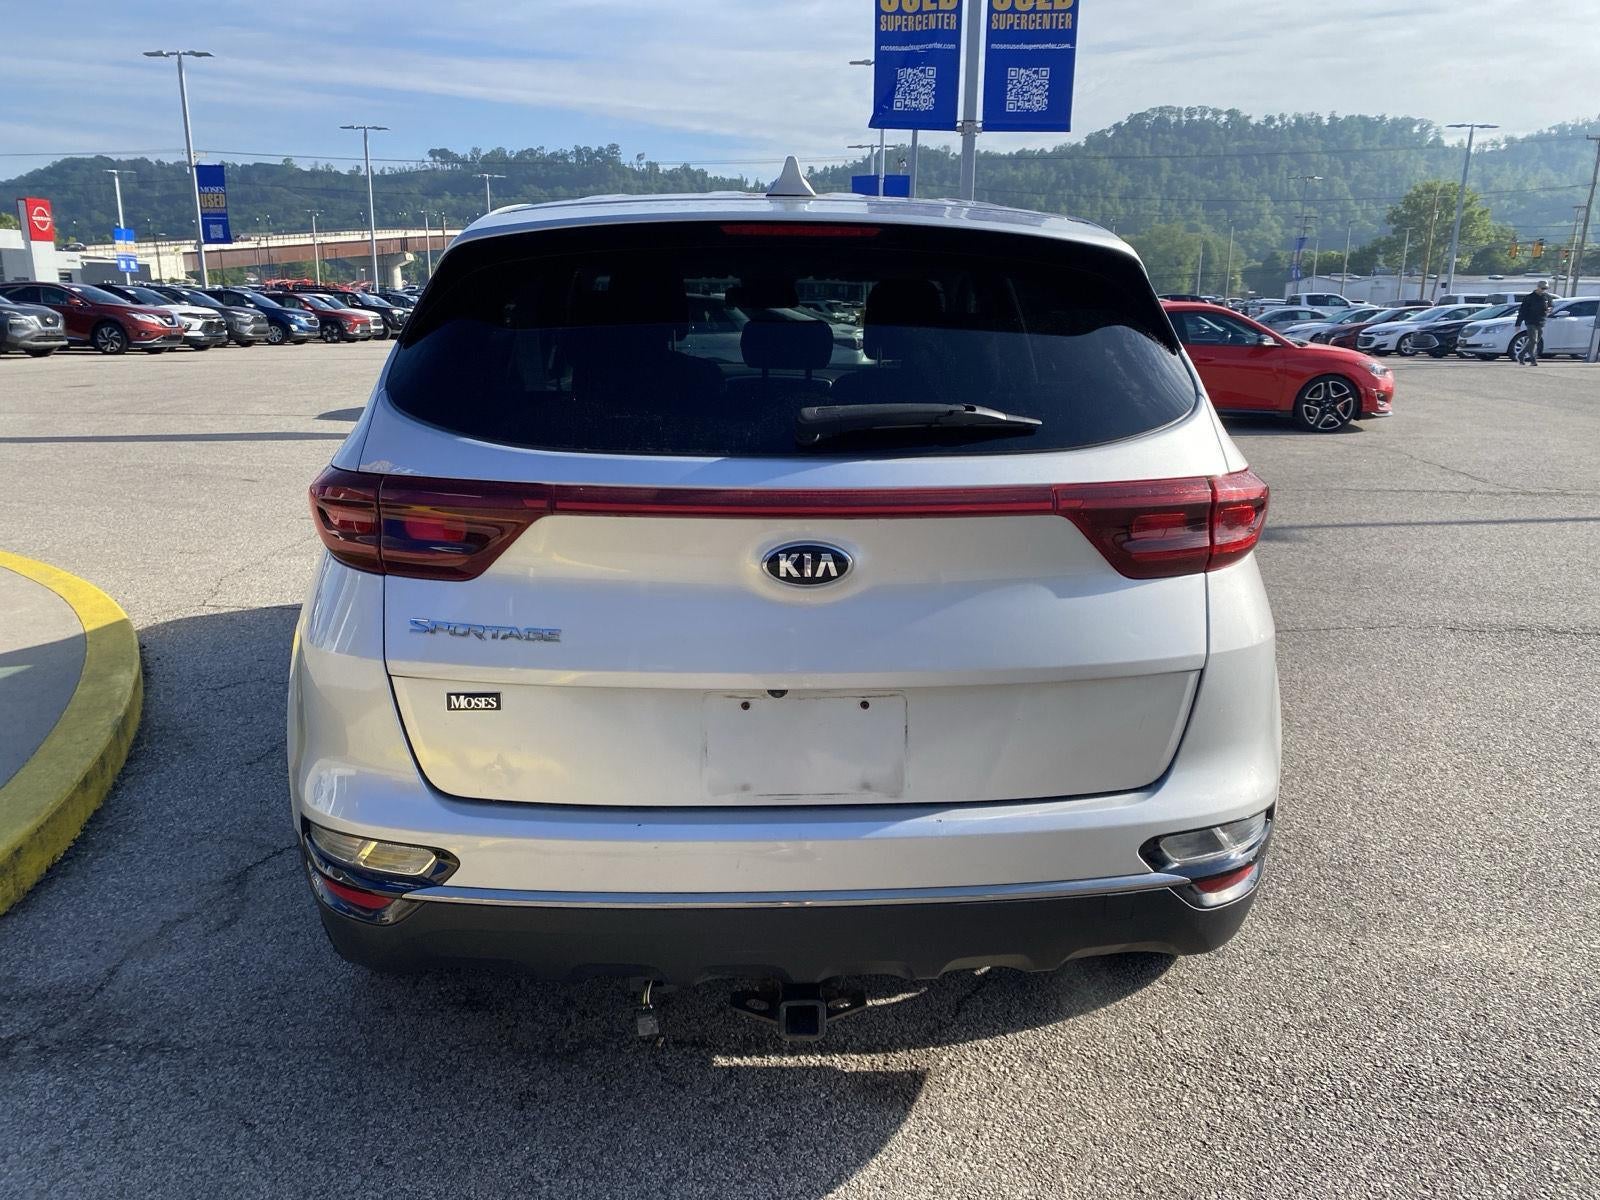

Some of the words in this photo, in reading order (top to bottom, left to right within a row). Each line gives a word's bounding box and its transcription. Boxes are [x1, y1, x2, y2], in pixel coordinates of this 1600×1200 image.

[880, 13, 957, 32] SUPERCENTER
[991, 13, 1073, 30] SUPERCENTER
[880, 42, 956, 52] mosesusedsupercenter.com
[991, 43, 1070, 51] mosesusedsupercenter.com
[200, 193, 226, 208] USED
[778, 553, 838, 578] KIA
[409, 617, 562, 643] SPORTAGE
